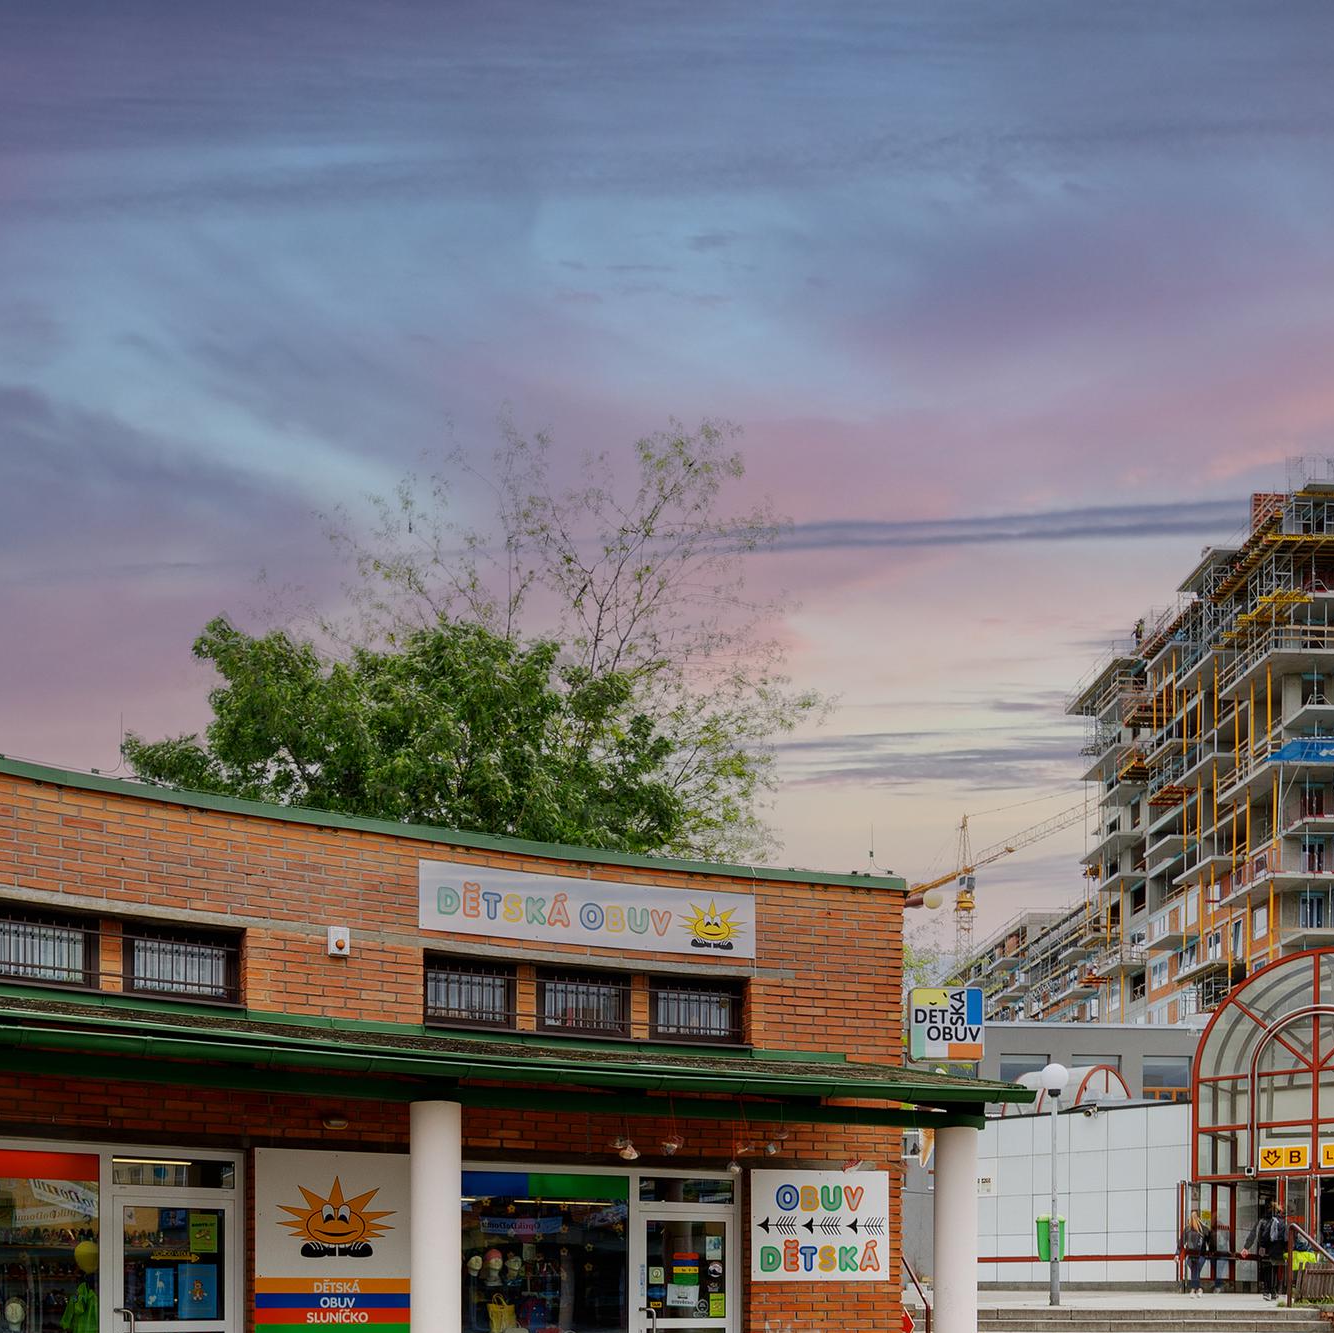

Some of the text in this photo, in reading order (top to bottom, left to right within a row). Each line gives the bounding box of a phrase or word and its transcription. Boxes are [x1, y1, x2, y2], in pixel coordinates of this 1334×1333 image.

[437, 881, 672, 937] DĚTSKÁ OBUV
[927, 1026, 981, 1042] OBUV
[1289, 1150, 1301, 1164] B
[776, 1184, 864, 1212] OBUV
[760, 1239, 880, 1272] DĚTSKÁ
[313, 1279, 361, 1294] DĚTSKÁ
[319, 1296, 356, 1308] OBUV
[306, 1308, 369, 1324] SLUNÍČKO
